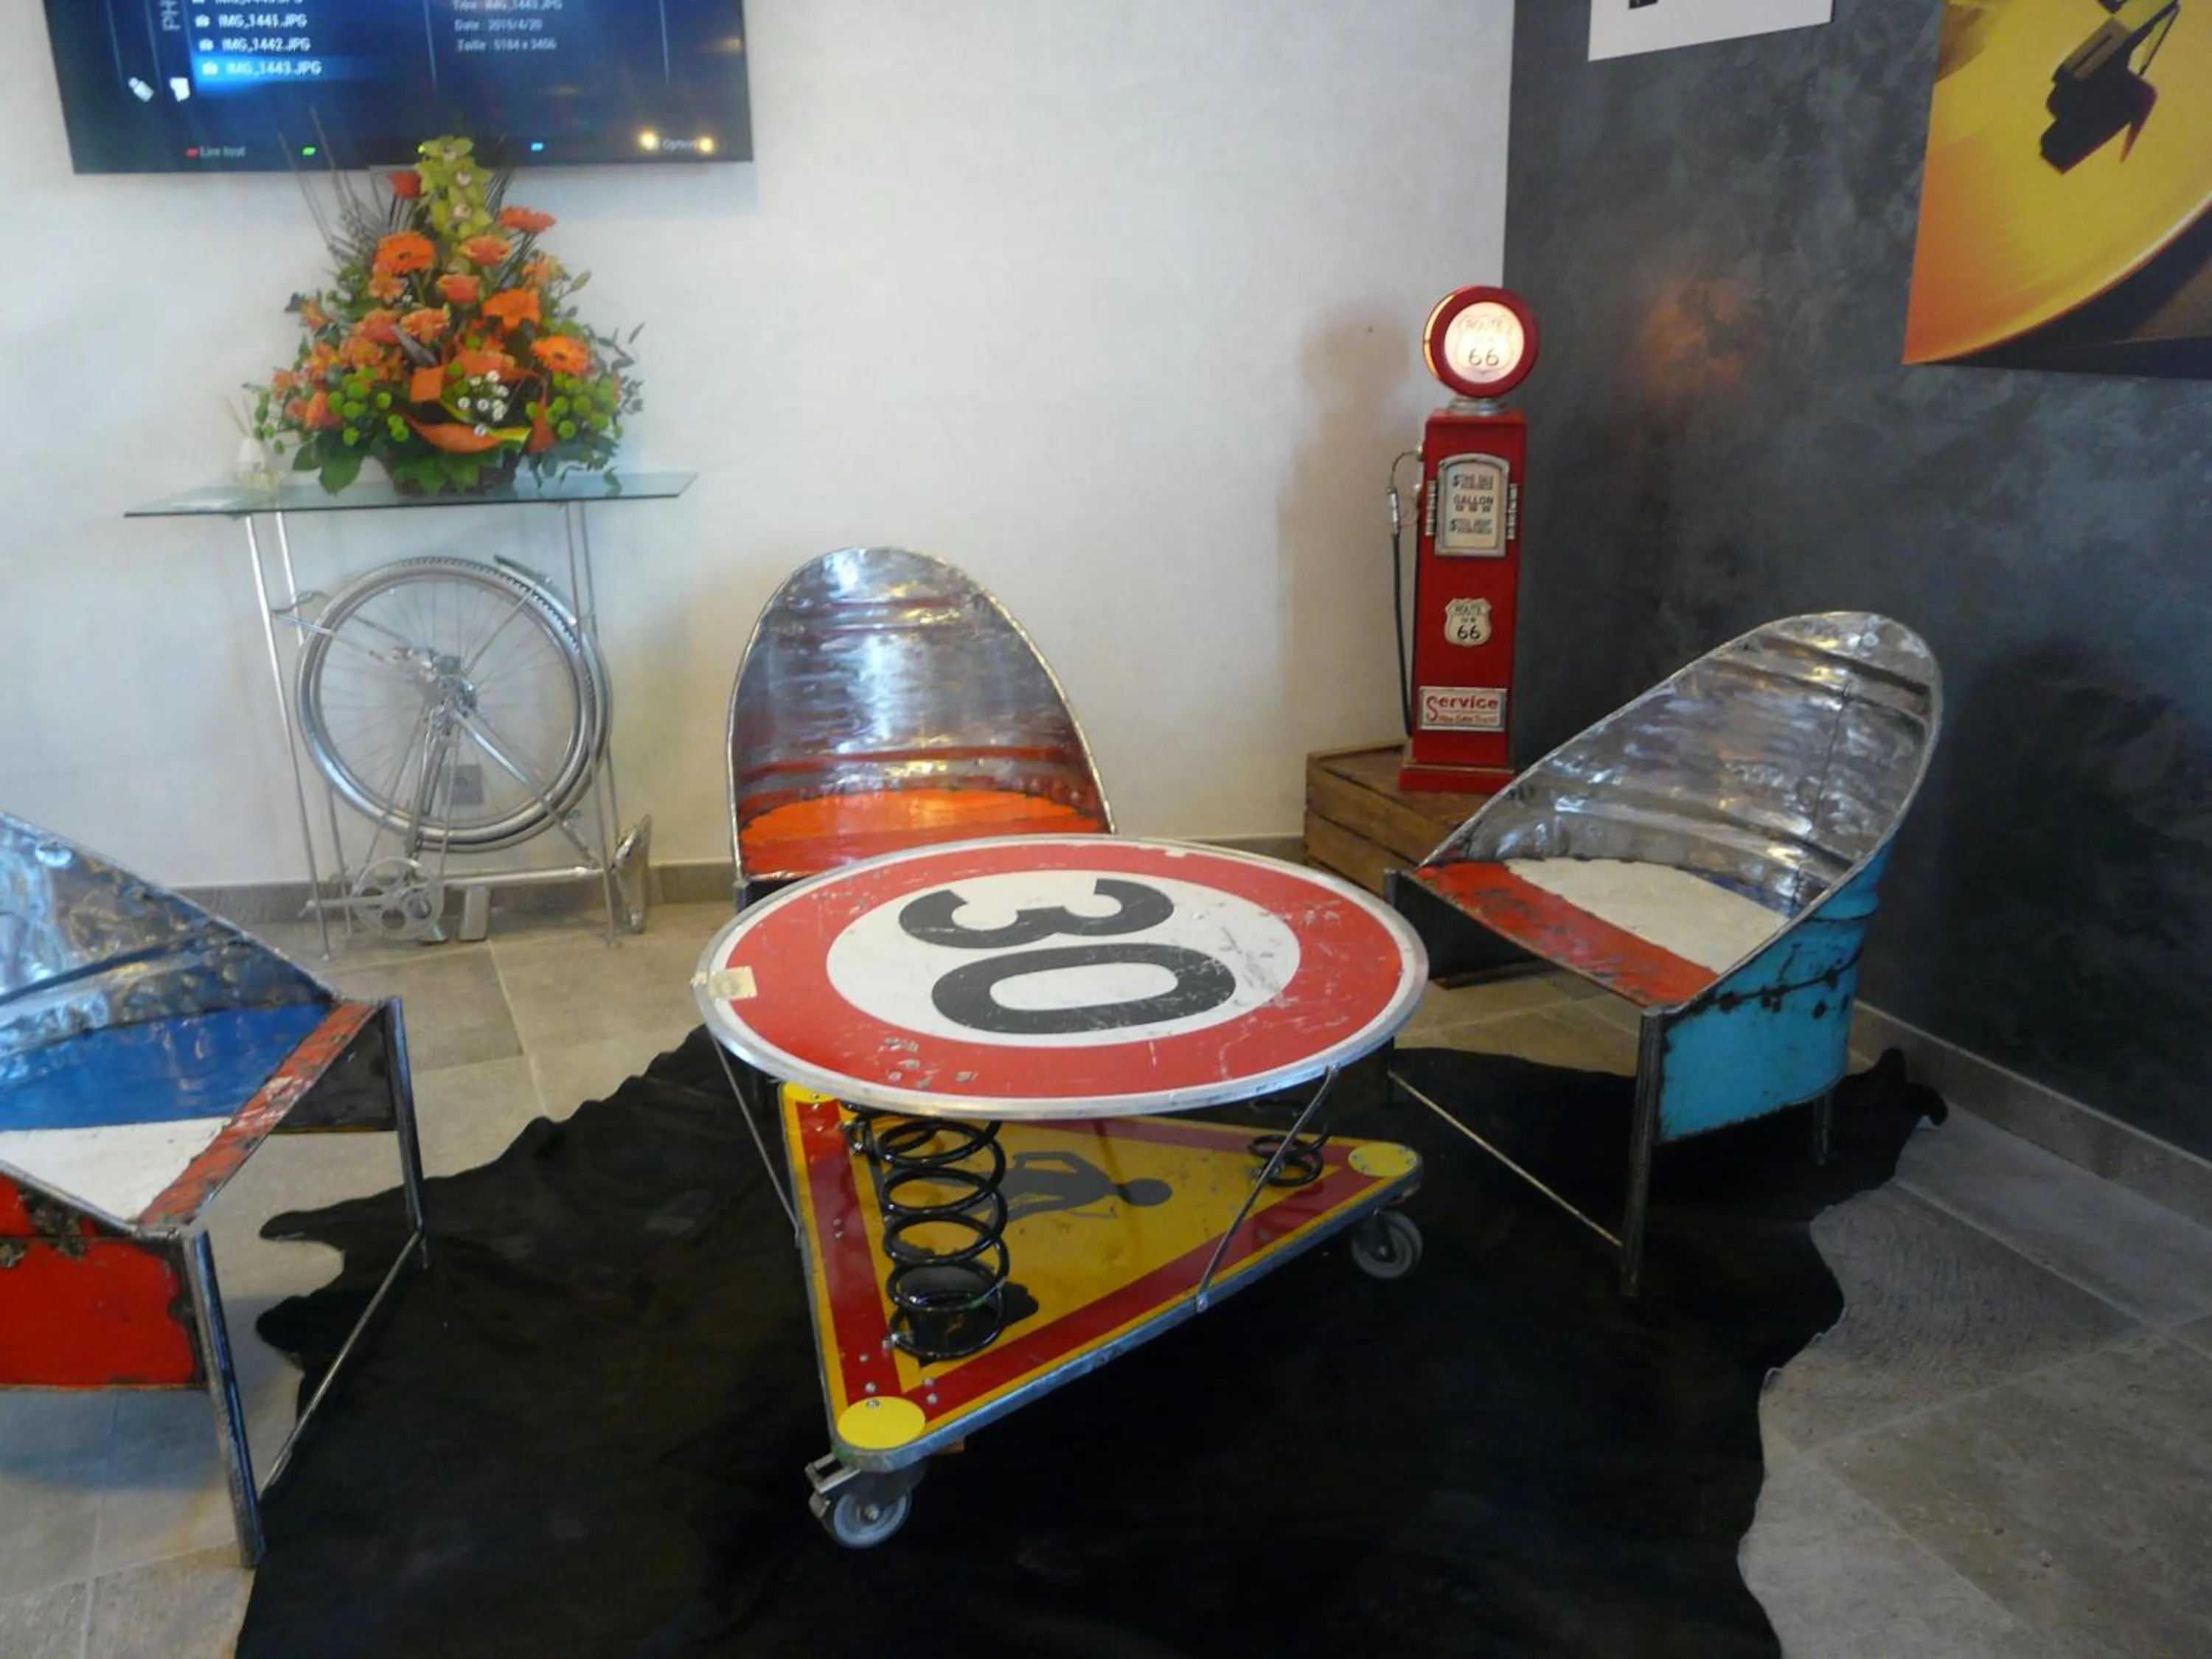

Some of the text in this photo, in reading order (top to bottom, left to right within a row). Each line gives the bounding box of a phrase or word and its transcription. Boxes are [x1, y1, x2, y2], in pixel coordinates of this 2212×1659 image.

[1468, 347, 1500, 367] 66
[1457, 625, 1481, 640] 66
[1426, 695, 1499, 722] Service
[898, 877, 1237, 1034] 30
